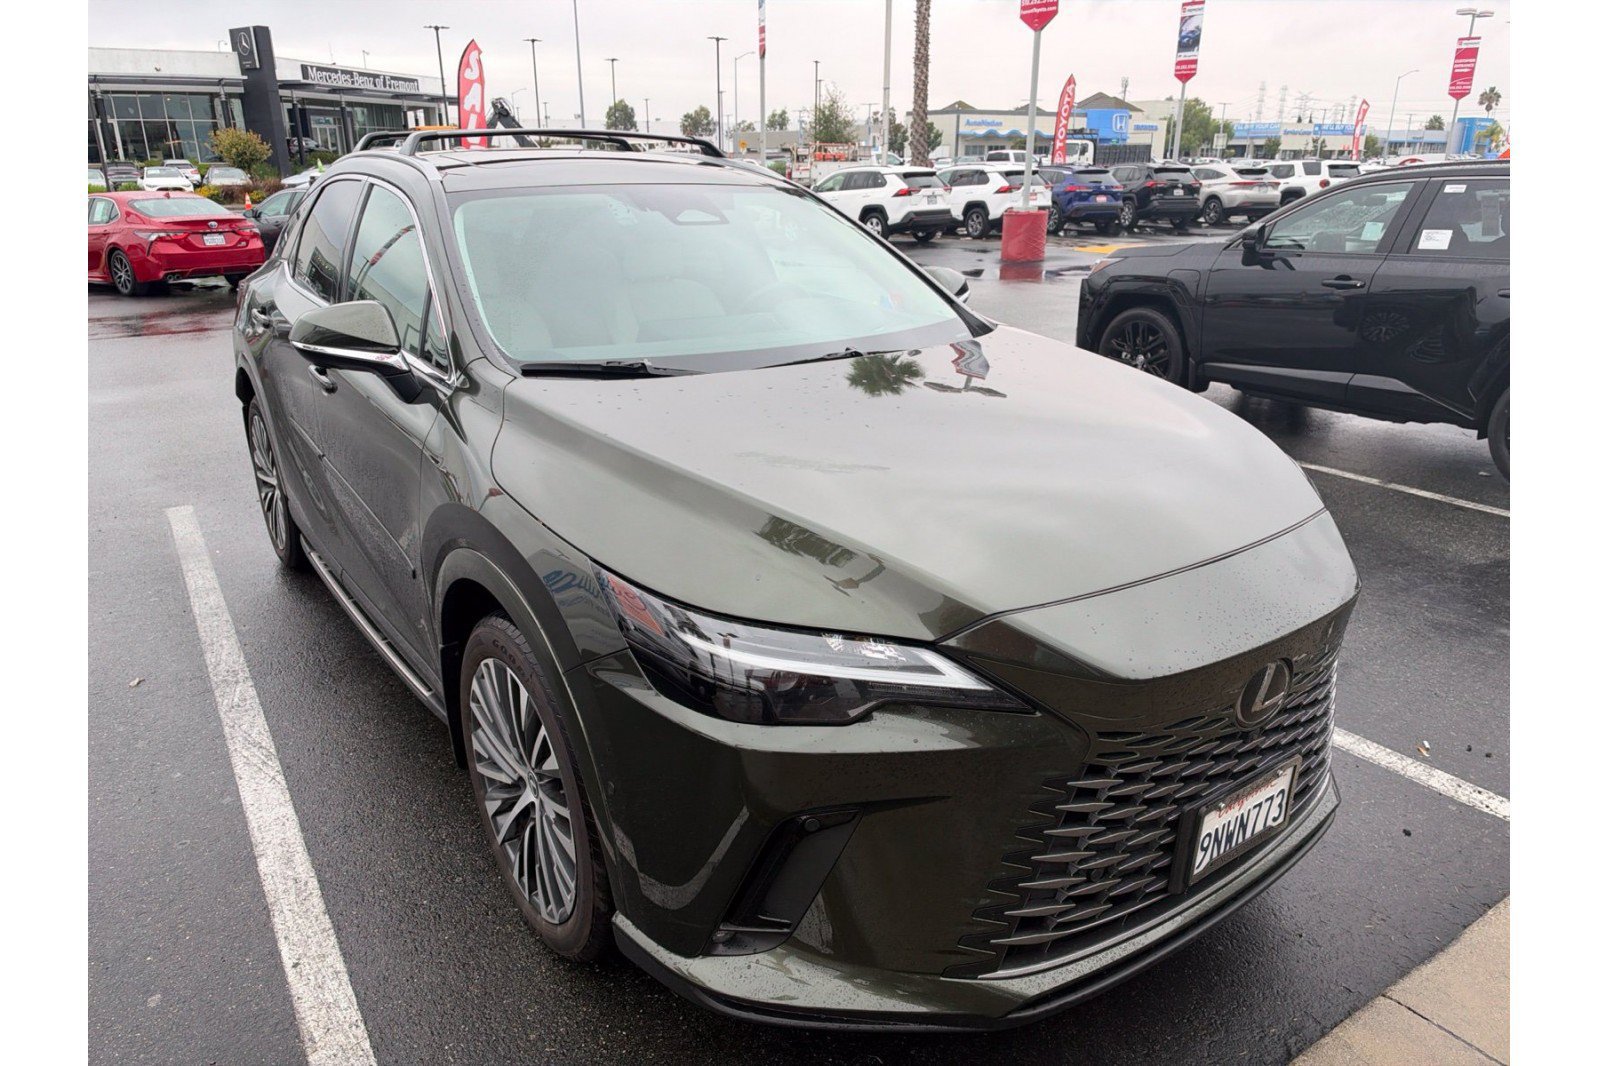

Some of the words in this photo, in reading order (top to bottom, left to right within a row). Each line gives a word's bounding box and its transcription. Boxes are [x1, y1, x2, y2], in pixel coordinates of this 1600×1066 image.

[307, 66, 374, 88] Mercedes-Benz
[376, 74, 384, 89] of
[386, 76, 419, 92] Fremont
[1056, 84, 1075, 150] TOYOTA
[1196, 788, 1286, 870] 9NWN773
